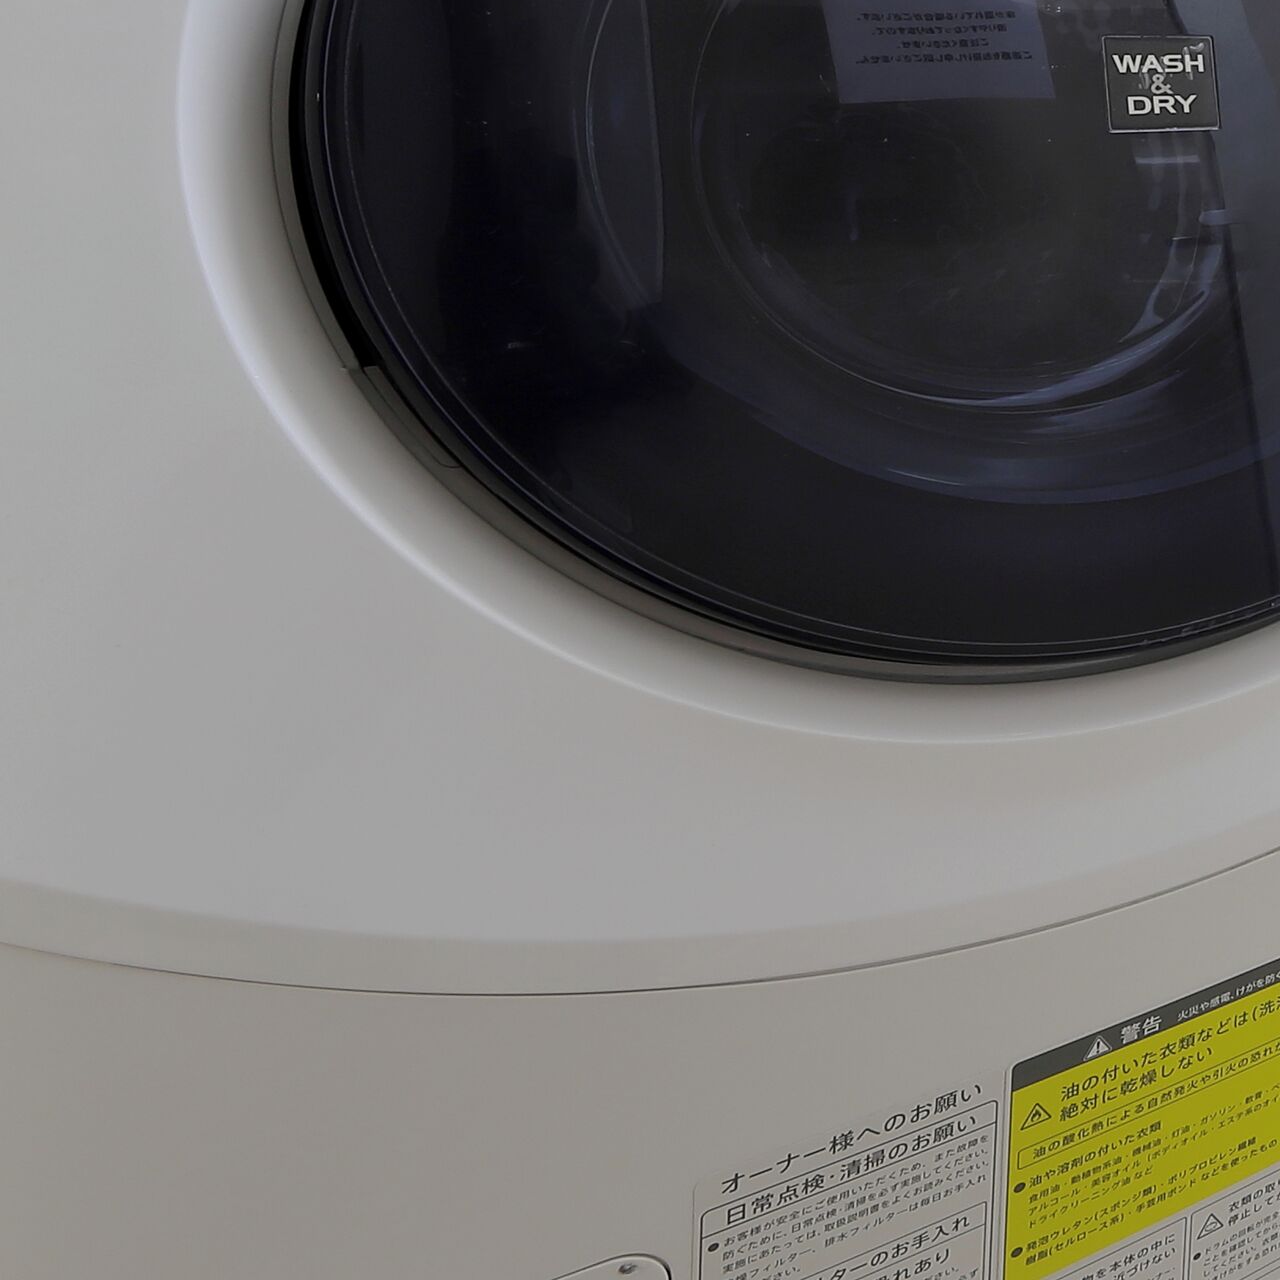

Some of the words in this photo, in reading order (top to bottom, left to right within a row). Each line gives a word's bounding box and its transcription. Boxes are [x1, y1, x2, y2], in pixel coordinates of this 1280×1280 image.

[1112, 53, 1205, 75] WASH
[1150, 74, 1172, 95] &
[1127, 93, 1198, 116] DRY
[1120, 1015, 1161, 1046] 警告
[1059, 1046, 1214, 1122] 絶対に乾燥しない
[721, 1084, 982, 1195] オーナー様へのお願い
[726, 1115, 976, 1226] 日常点検・清掃のお願い
